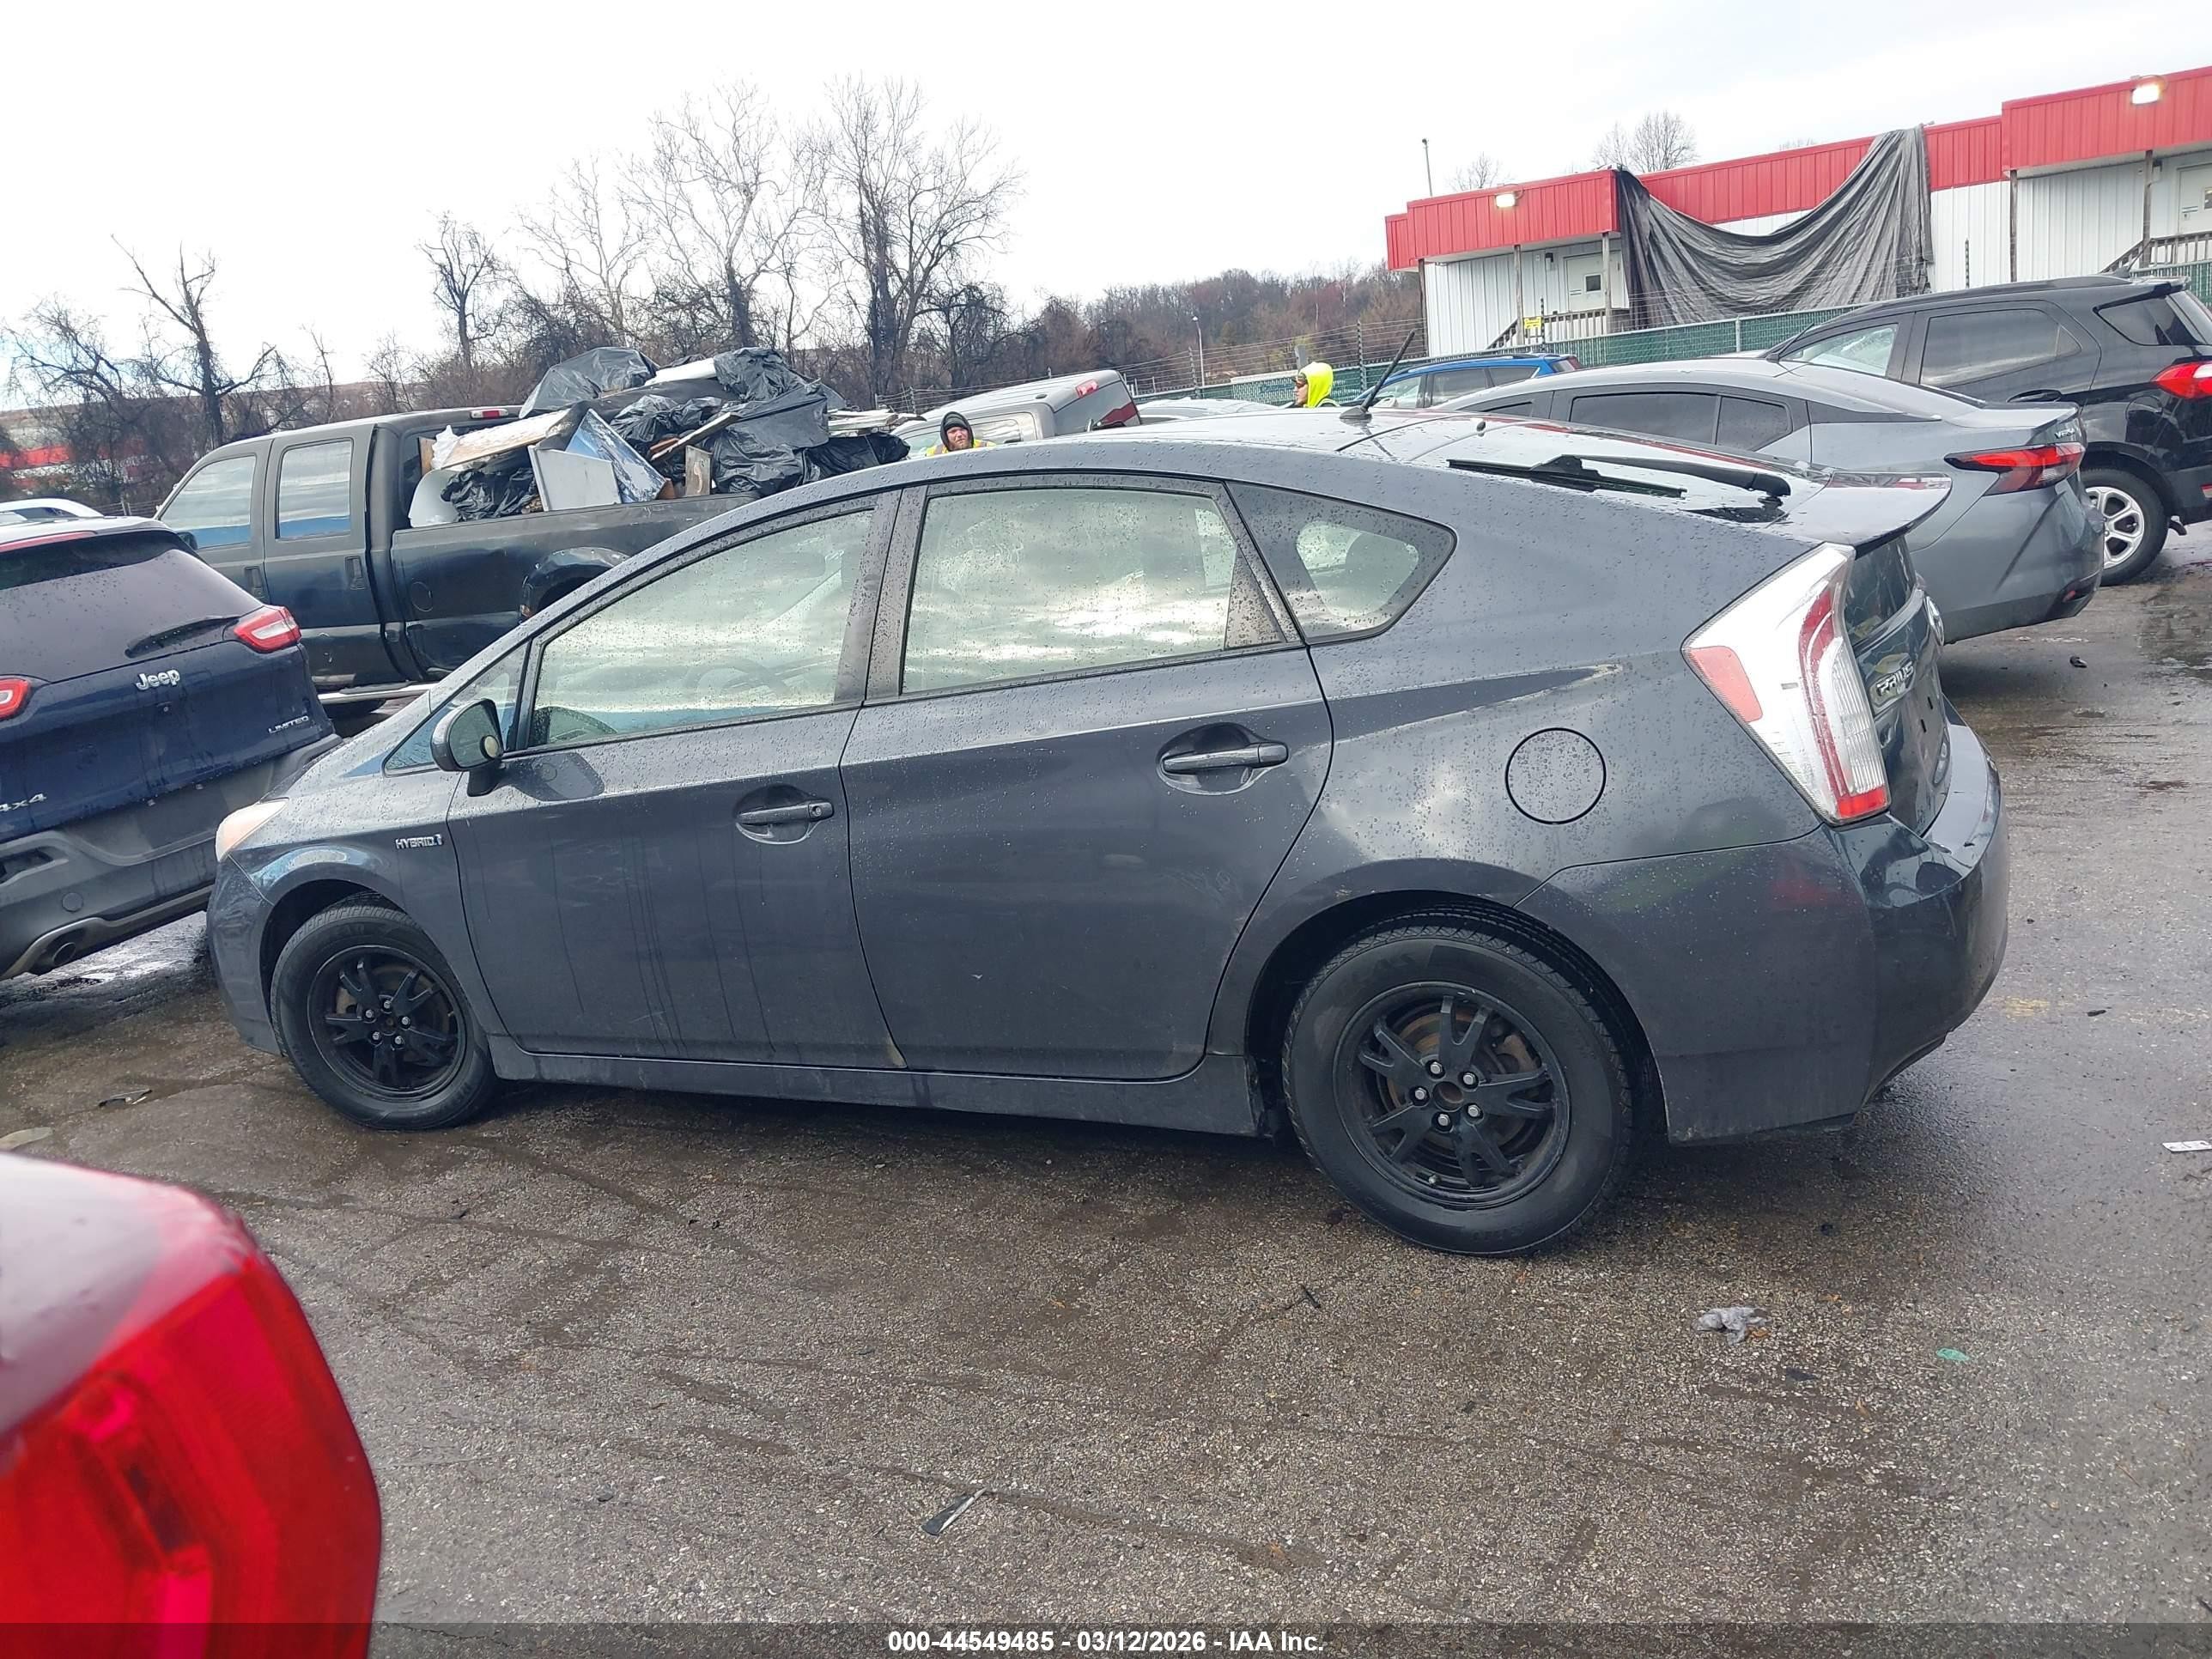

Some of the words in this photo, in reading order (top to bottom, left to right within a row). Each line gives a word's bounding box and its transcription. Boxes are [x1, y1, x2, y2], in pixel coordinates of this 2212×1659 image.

[136, 670, 180, 690] Jeep
[1876, 661, 1914, 694] PRIUS
[268, 715, 309, 734] LIMITED
[395, 836, 434, 849] HYBRID
